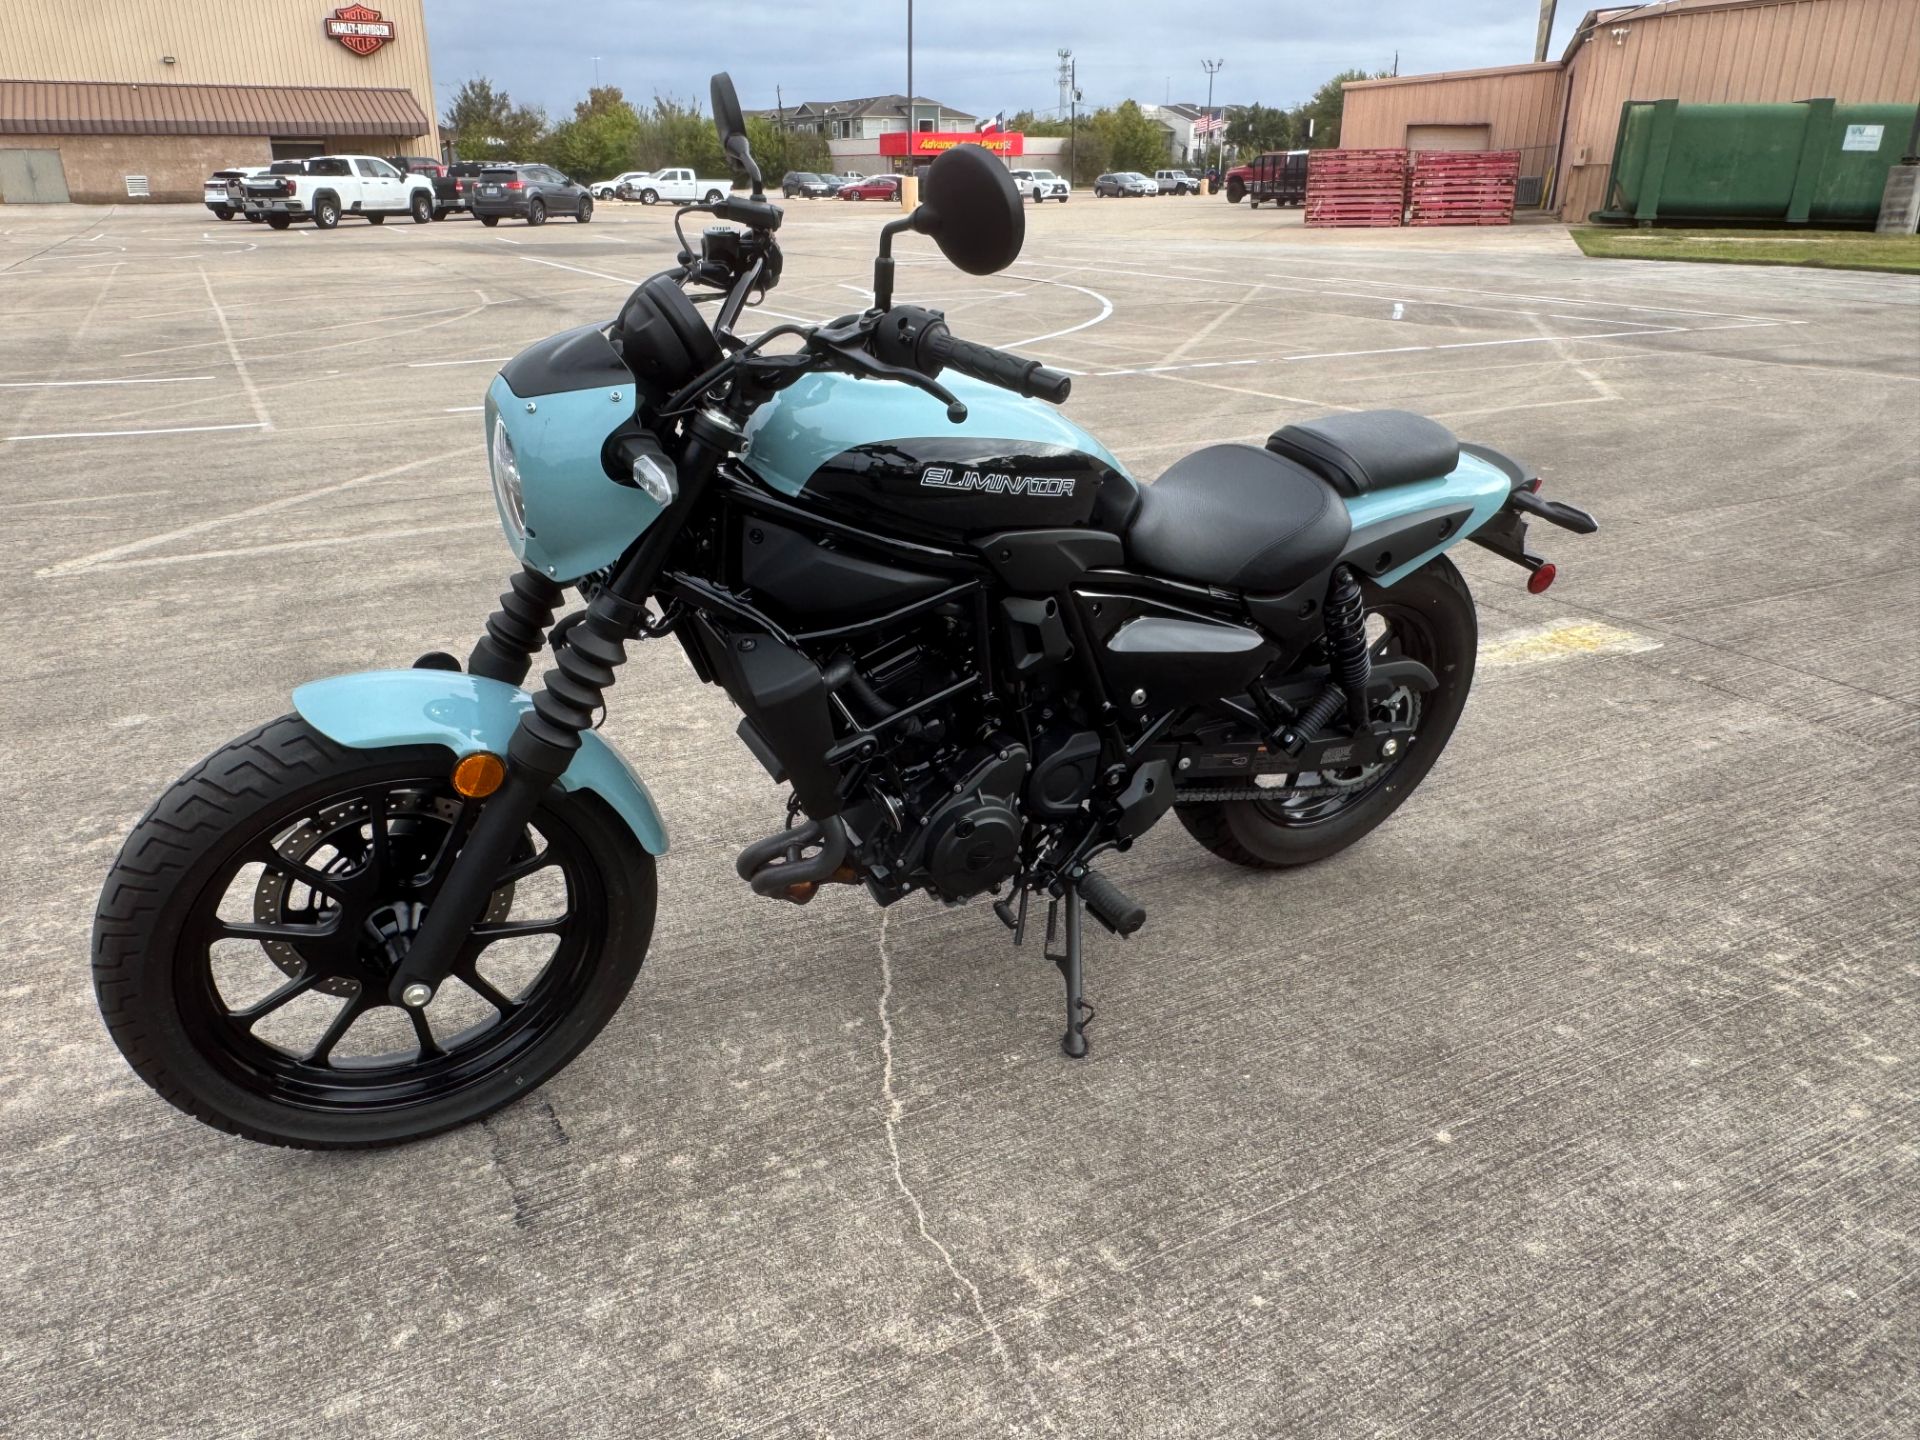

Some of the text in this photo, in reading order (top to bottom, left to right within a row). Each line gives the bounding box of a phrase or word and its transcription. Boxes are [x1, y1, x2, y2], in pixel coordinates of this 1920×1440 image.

[343, 9, 374, 20] MOTOR
[331, 22, 390, 36] HARLEY-DAVIDSON
[345, 37, 377, 51] CYCLES
[920, 467, 1075, 496] ELIMINATOR
